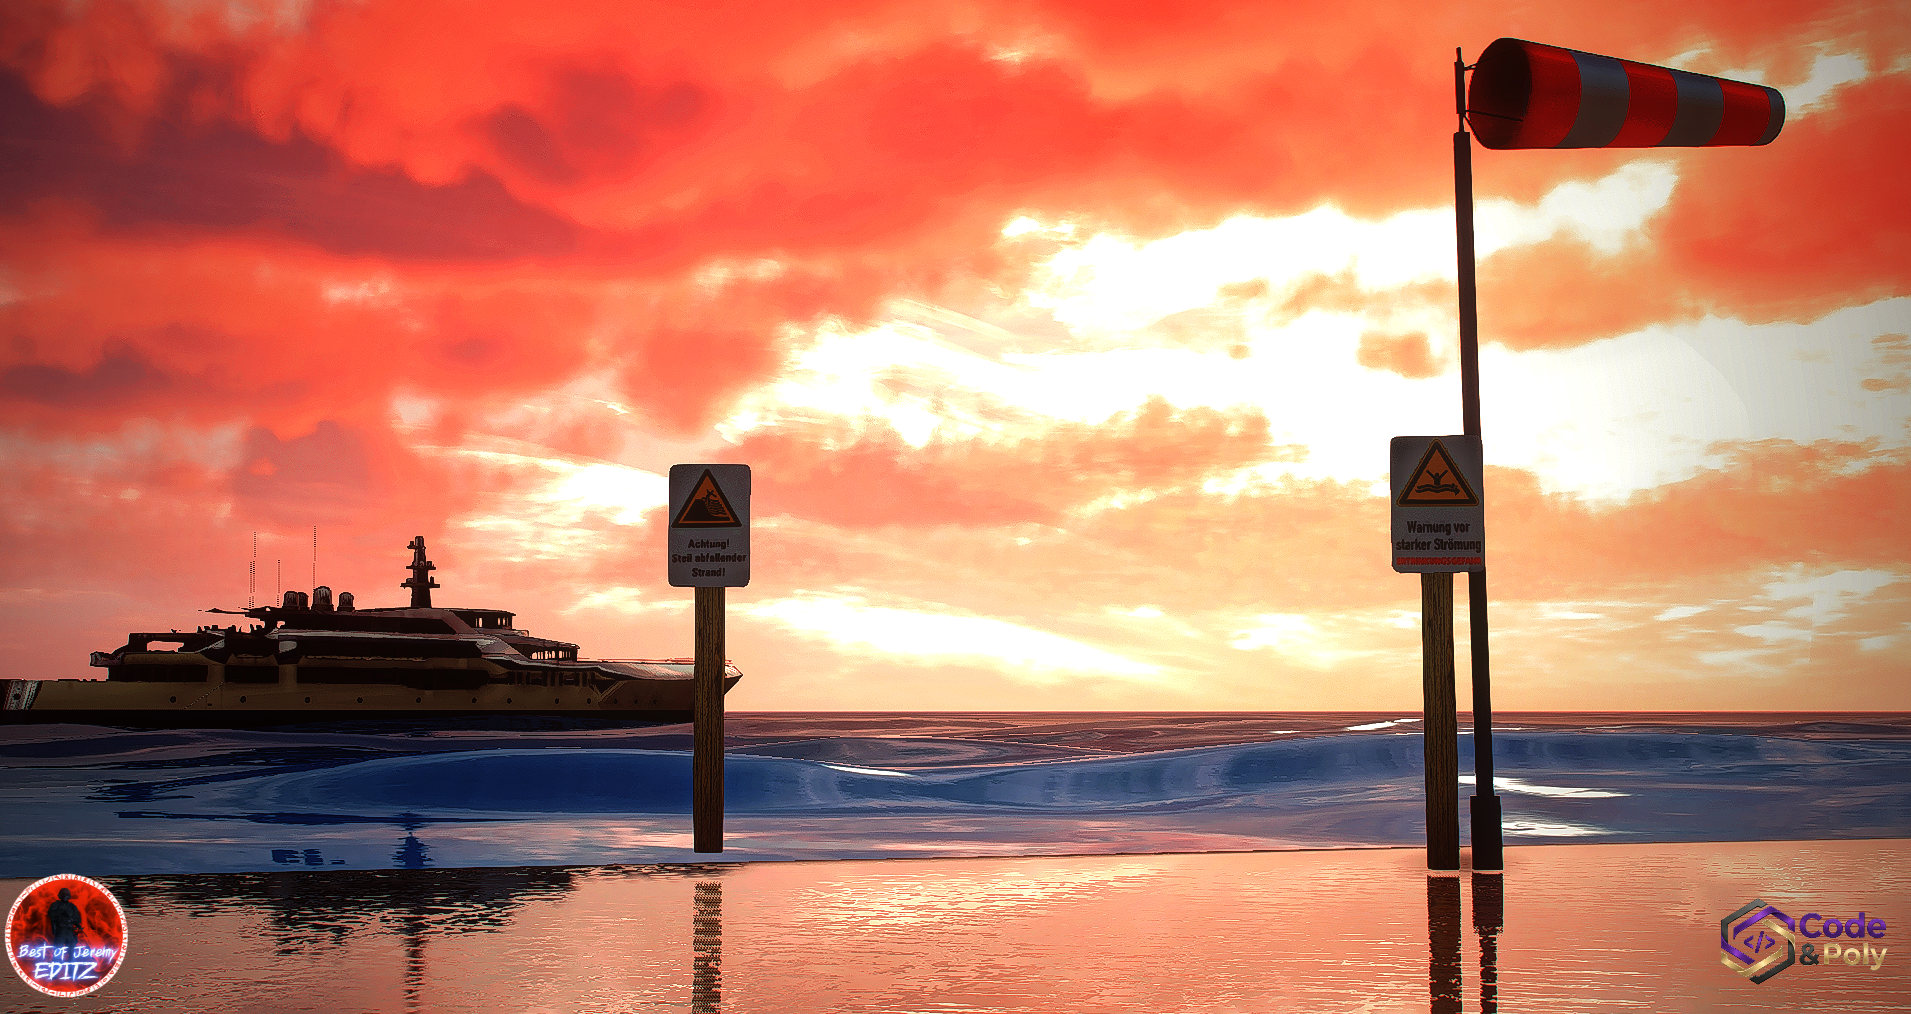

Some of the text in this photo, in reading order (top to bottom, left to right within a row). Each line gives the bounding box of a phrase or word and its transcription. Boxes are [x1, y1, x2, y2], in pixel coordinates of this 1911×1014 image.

[1407, 521, 1470, 535] Warnung vor
[688, 539, 729, 549] Achtung!
[1396, 538, 1481, 553] starker Strömung
[672, 553, 747, 563] Steil abfallender
[692, 568, 725, 577] Strand!
